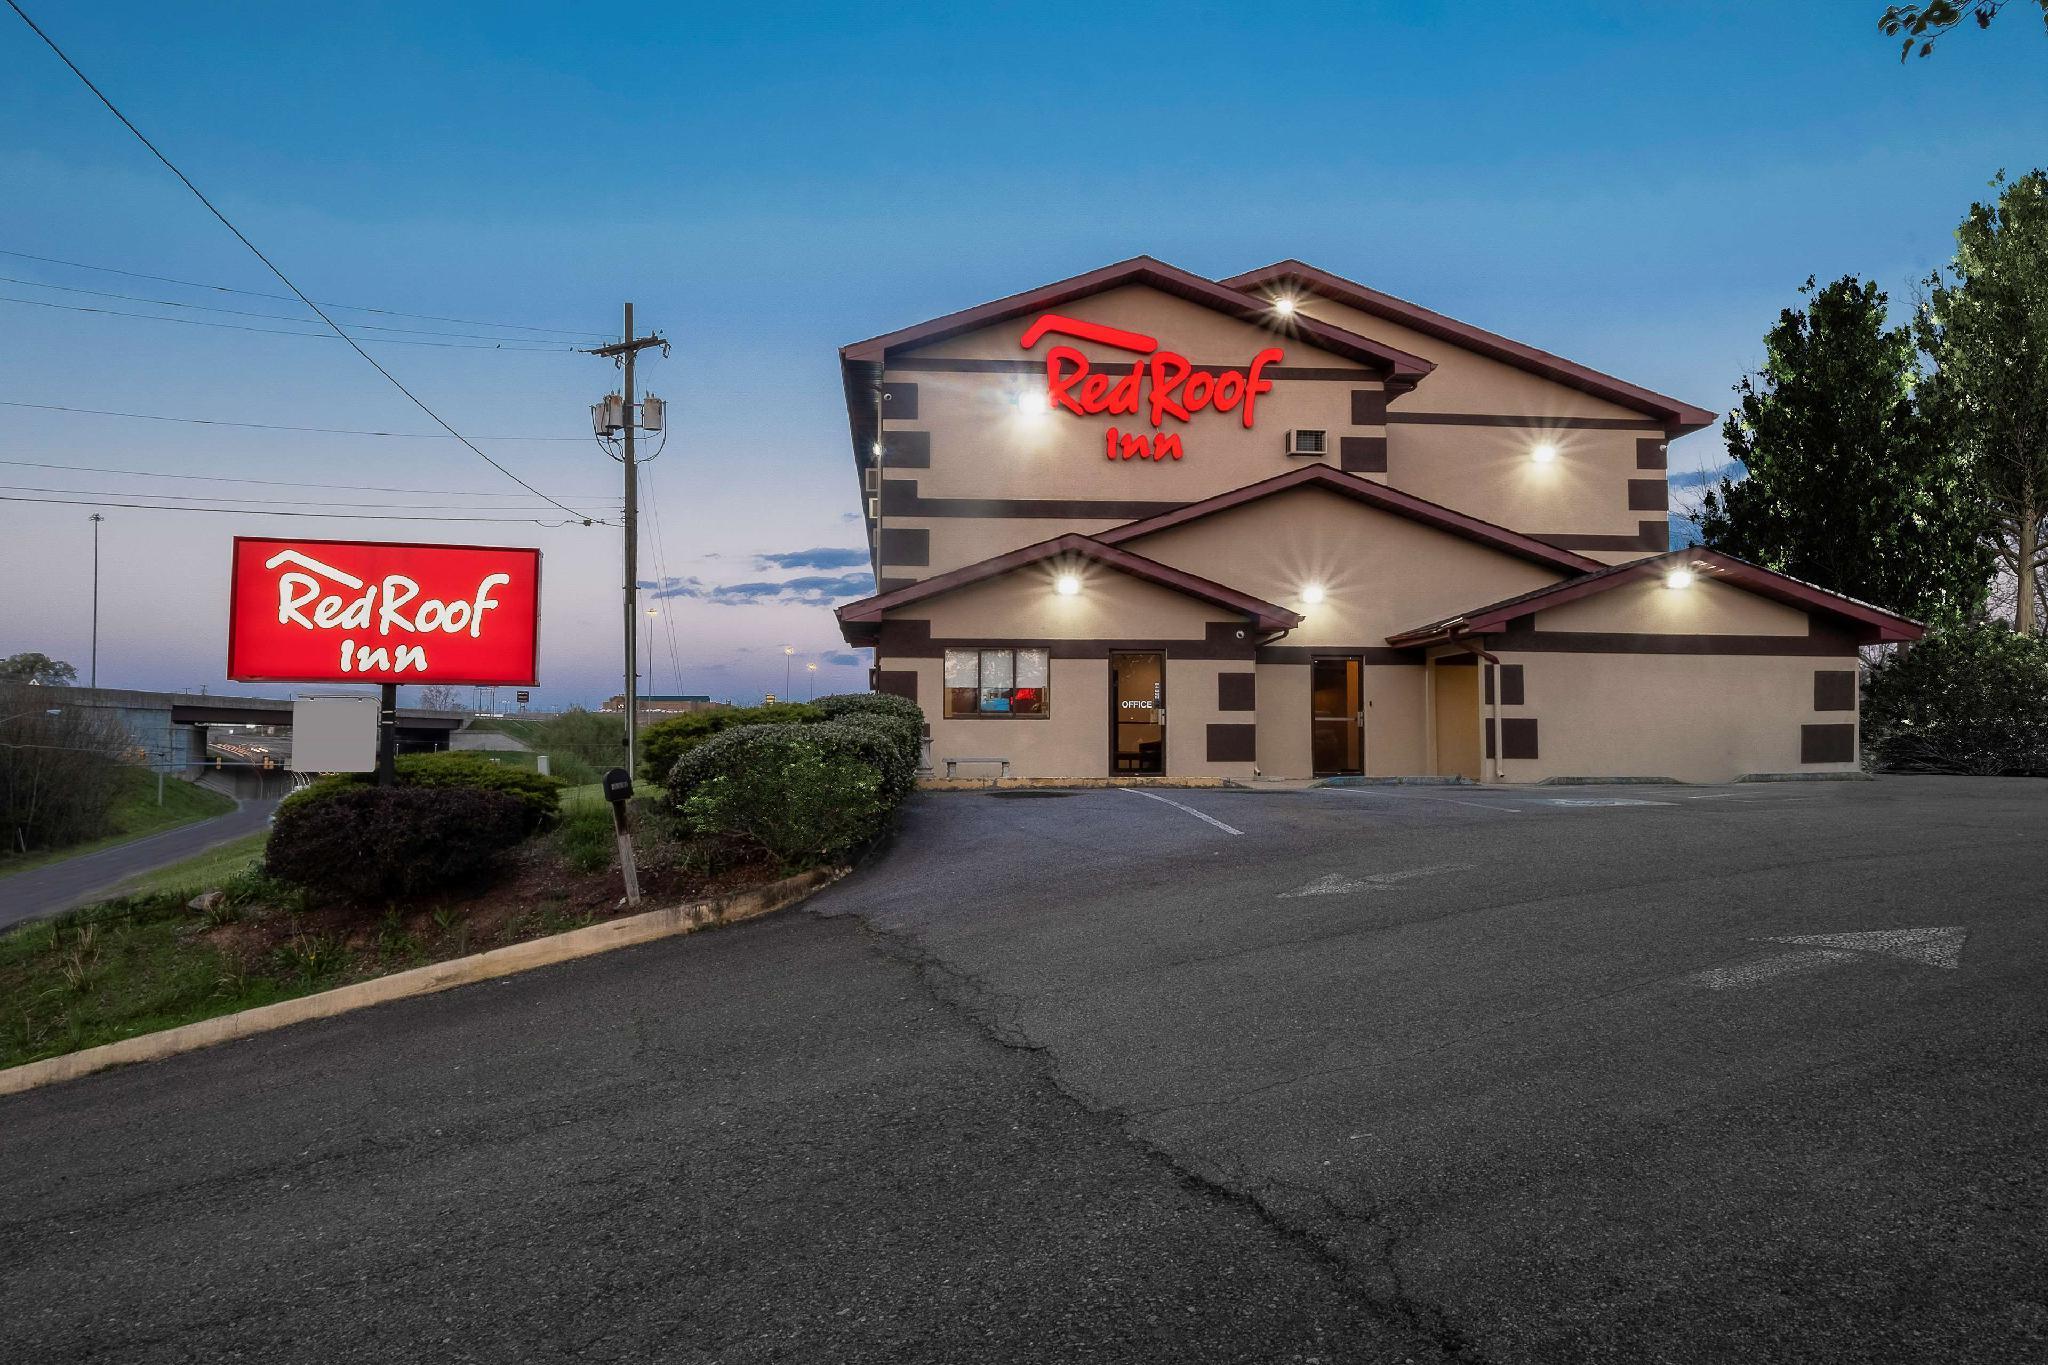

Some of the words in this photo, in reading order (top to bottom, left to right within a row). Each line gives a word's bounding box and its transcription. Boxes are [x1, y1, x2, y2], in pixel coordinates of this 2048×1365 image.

[1106, 426, 1183, 461] Inn
[340, 639, 428, 673] Inn
[1121, 700, 1153, 709] OFFICE
